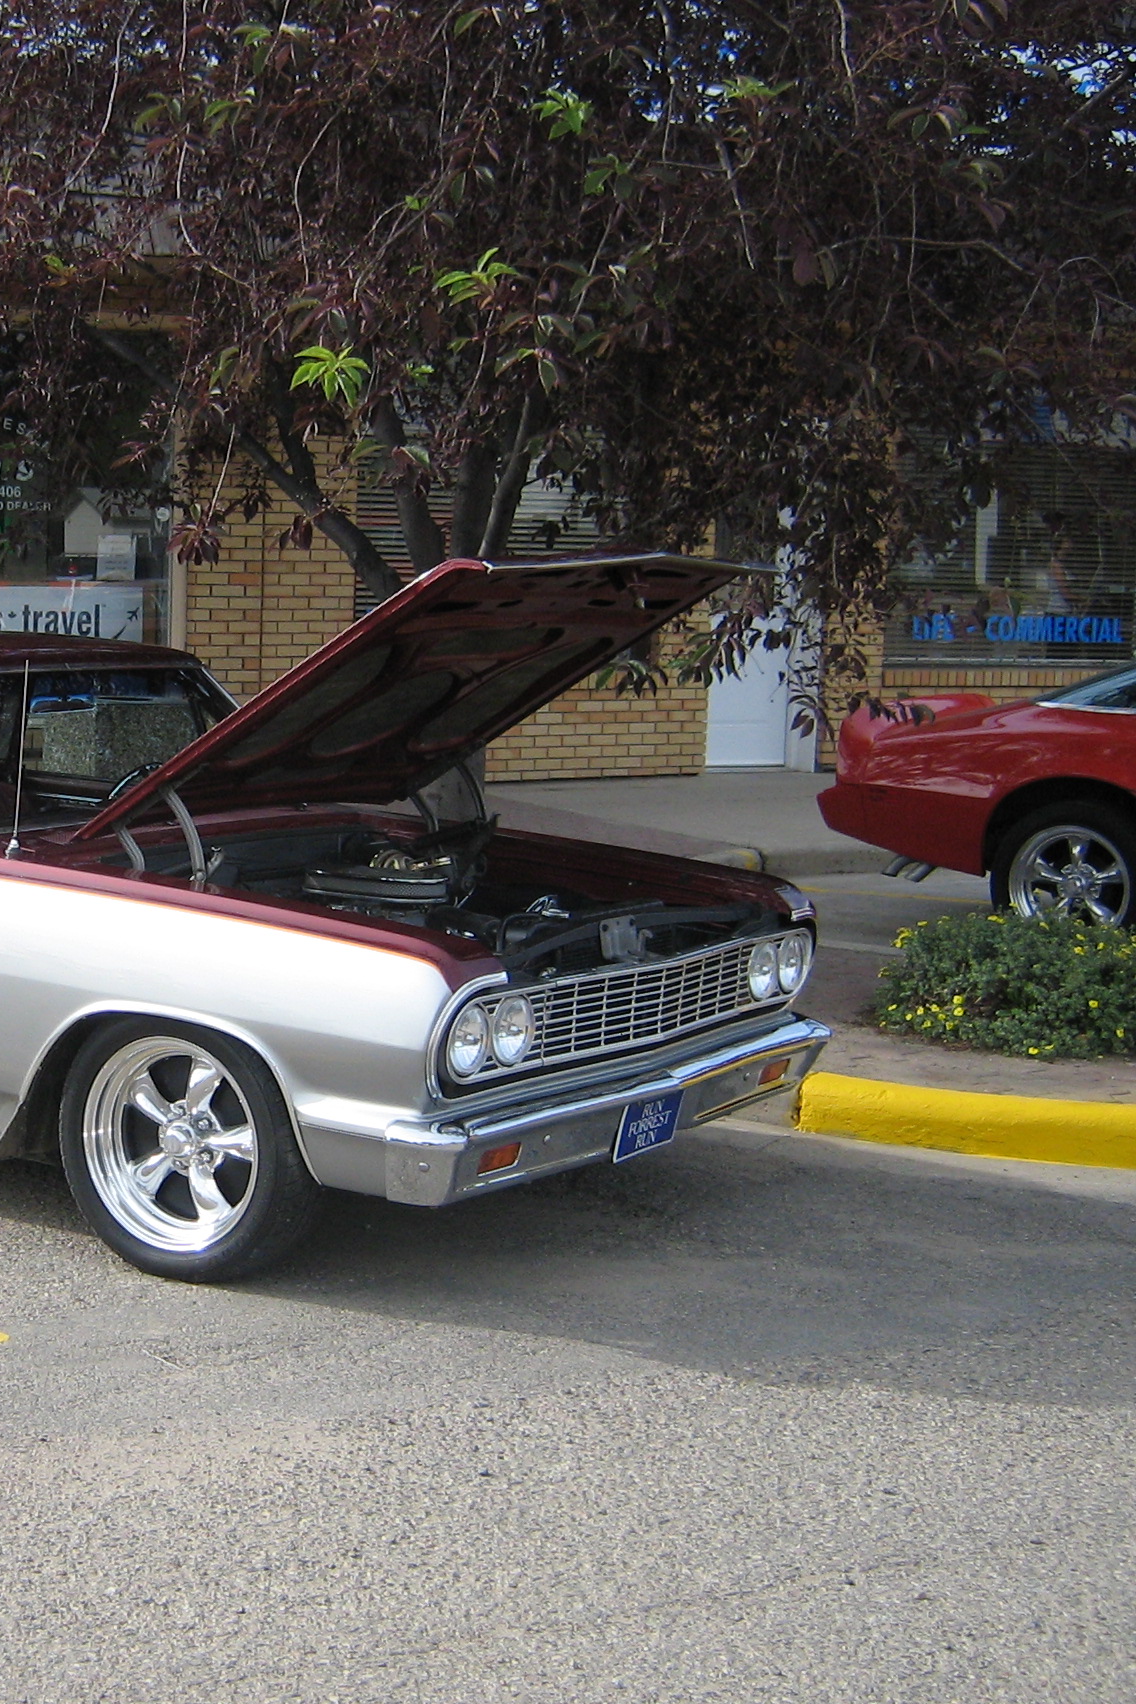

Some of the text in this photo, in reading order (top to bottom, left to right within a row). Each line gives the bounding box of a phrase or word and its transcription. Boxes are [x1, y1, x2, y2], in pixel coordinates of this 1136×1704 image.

[22, 604, 101, 637] travel
[984, 615, 1125, 643] COMMERCIAL
[642, 1099, 666, 1118] RUN
[627, 1110, 672, 1138] FORREST
[635, 1129, 657, 1149] RUN
